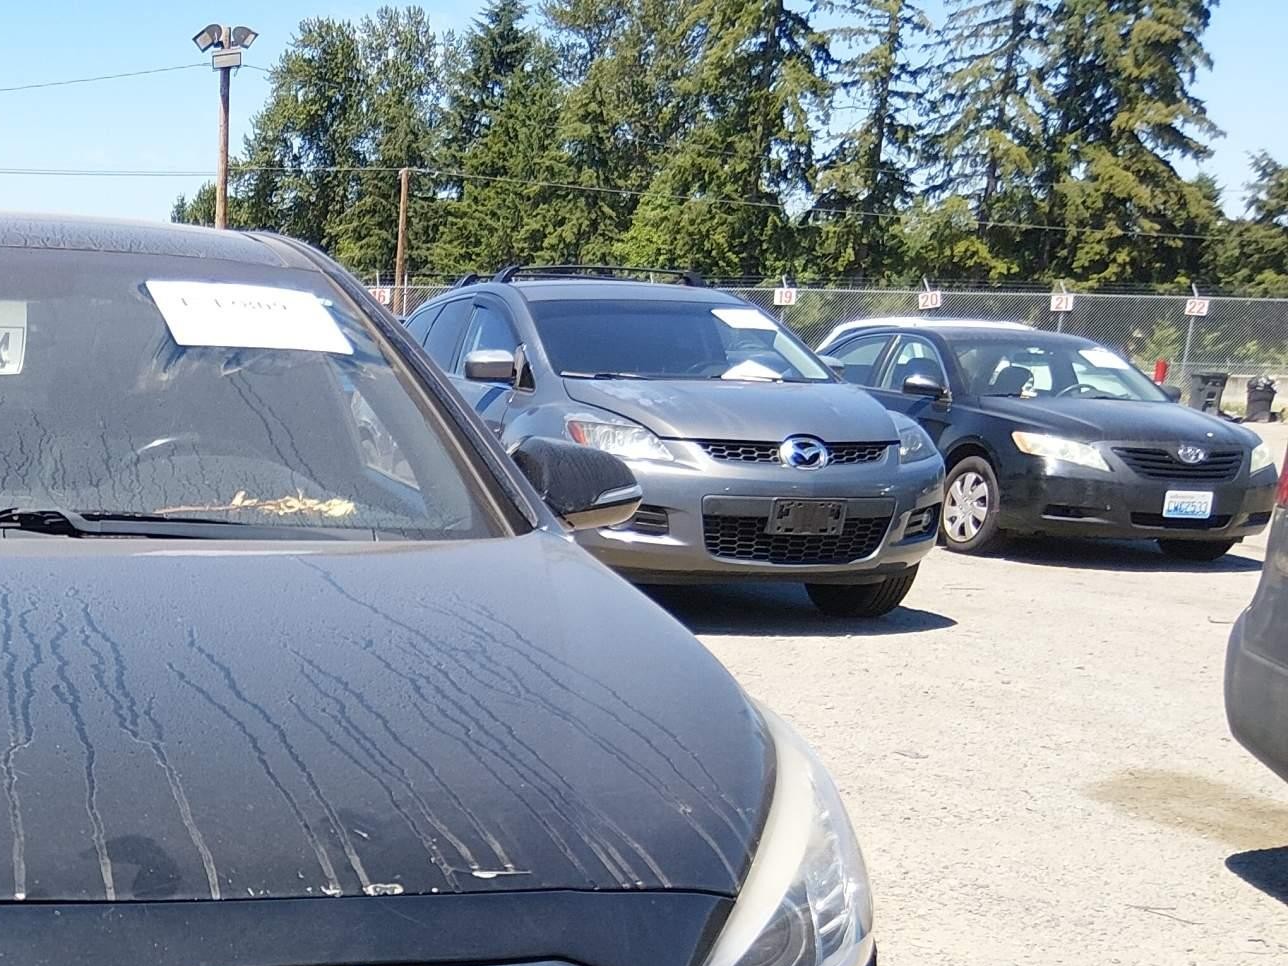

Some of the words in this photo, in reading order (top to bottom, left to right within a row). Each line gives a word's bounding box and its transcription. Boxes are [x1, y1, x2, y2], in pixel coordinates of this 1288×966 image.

[779, 290, 793, 304] 19
[920, 293, 937, 307] 20
[1054, 296, 1069, 310] 21
[1187, 301, 1206, 314] 22
